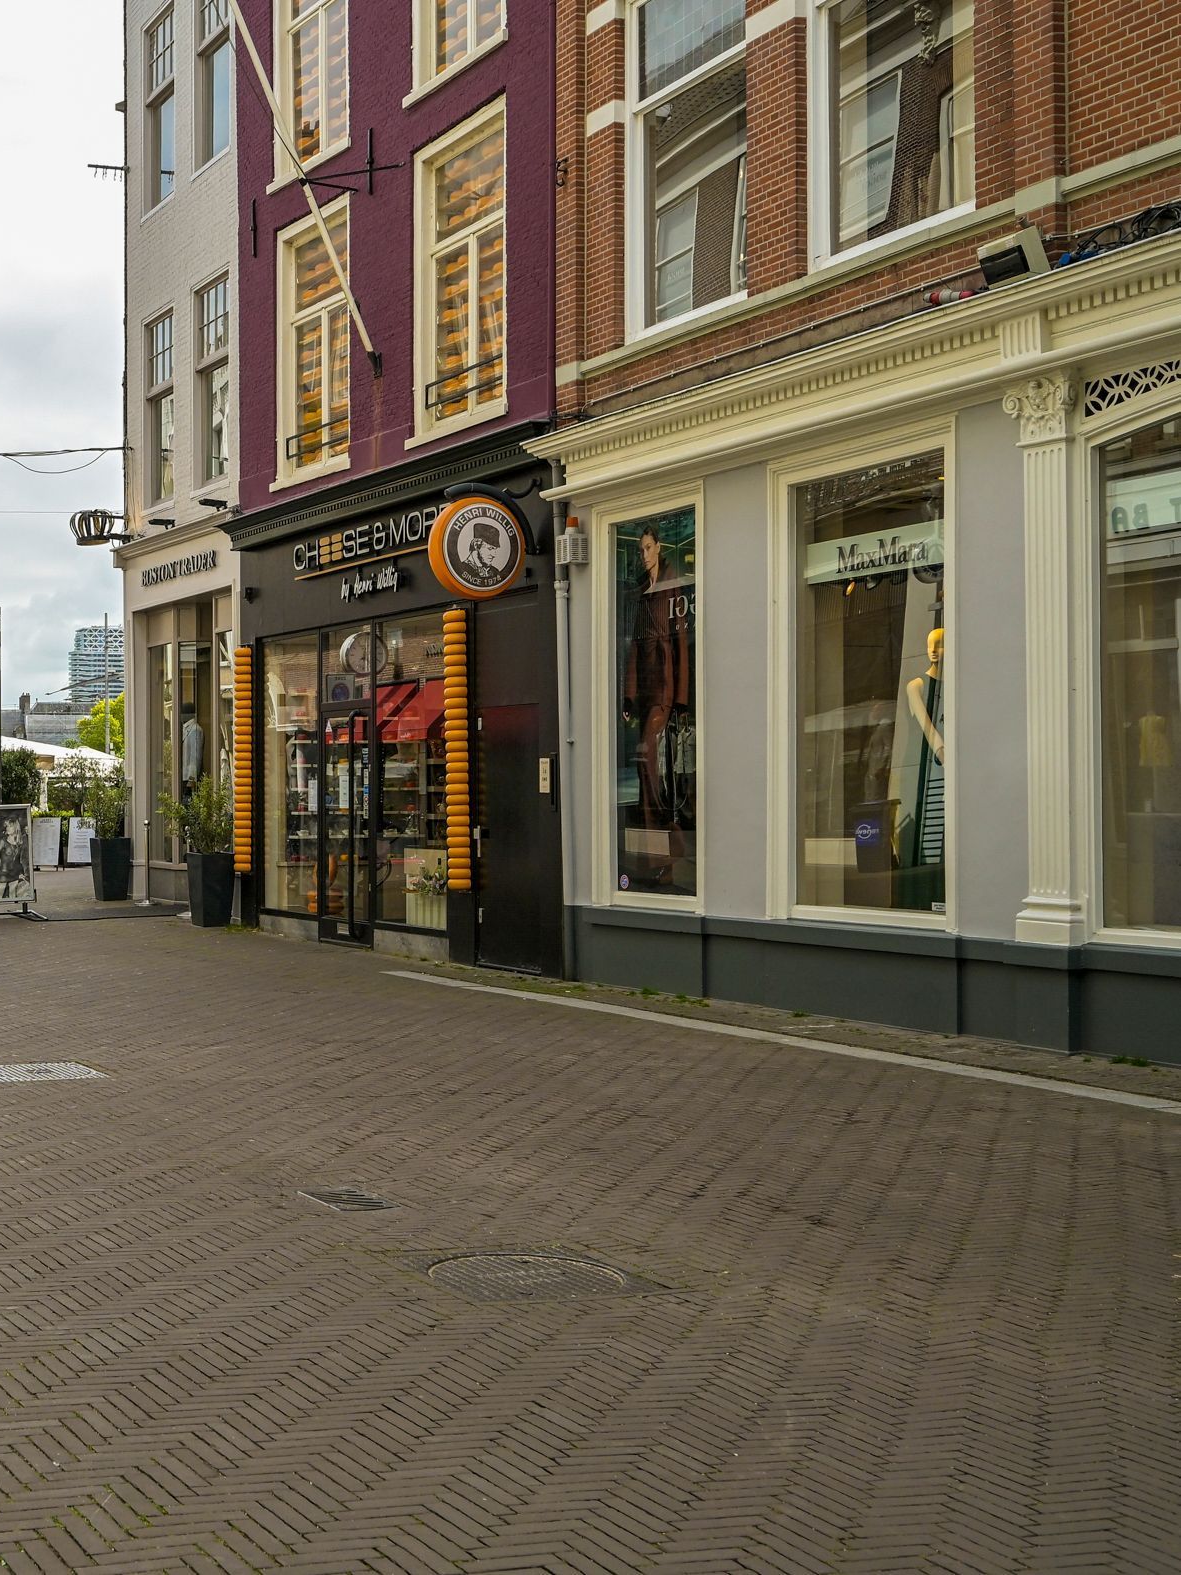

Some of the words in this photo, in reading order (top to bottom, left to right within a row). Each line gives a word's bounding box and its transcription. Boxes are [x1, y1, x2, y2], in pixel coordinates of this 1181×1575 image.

[373, 522, 386, 551] &
[453, 507, 483, 531] HENRI
[485, 508, 516, 537] WILLIG
[141, 560, 179, 587] BOSTON
[178, 549, 217, 577] TRADER
[836, 535, 928, 574] MaxMara
[340, 577, 350, 603] by
[353, 572, 374, 598] Henri
[376, 565, 398, 593] Willig
[461, 571, 482, 585] SINCE
[483, 574, 502, 587] 1974
